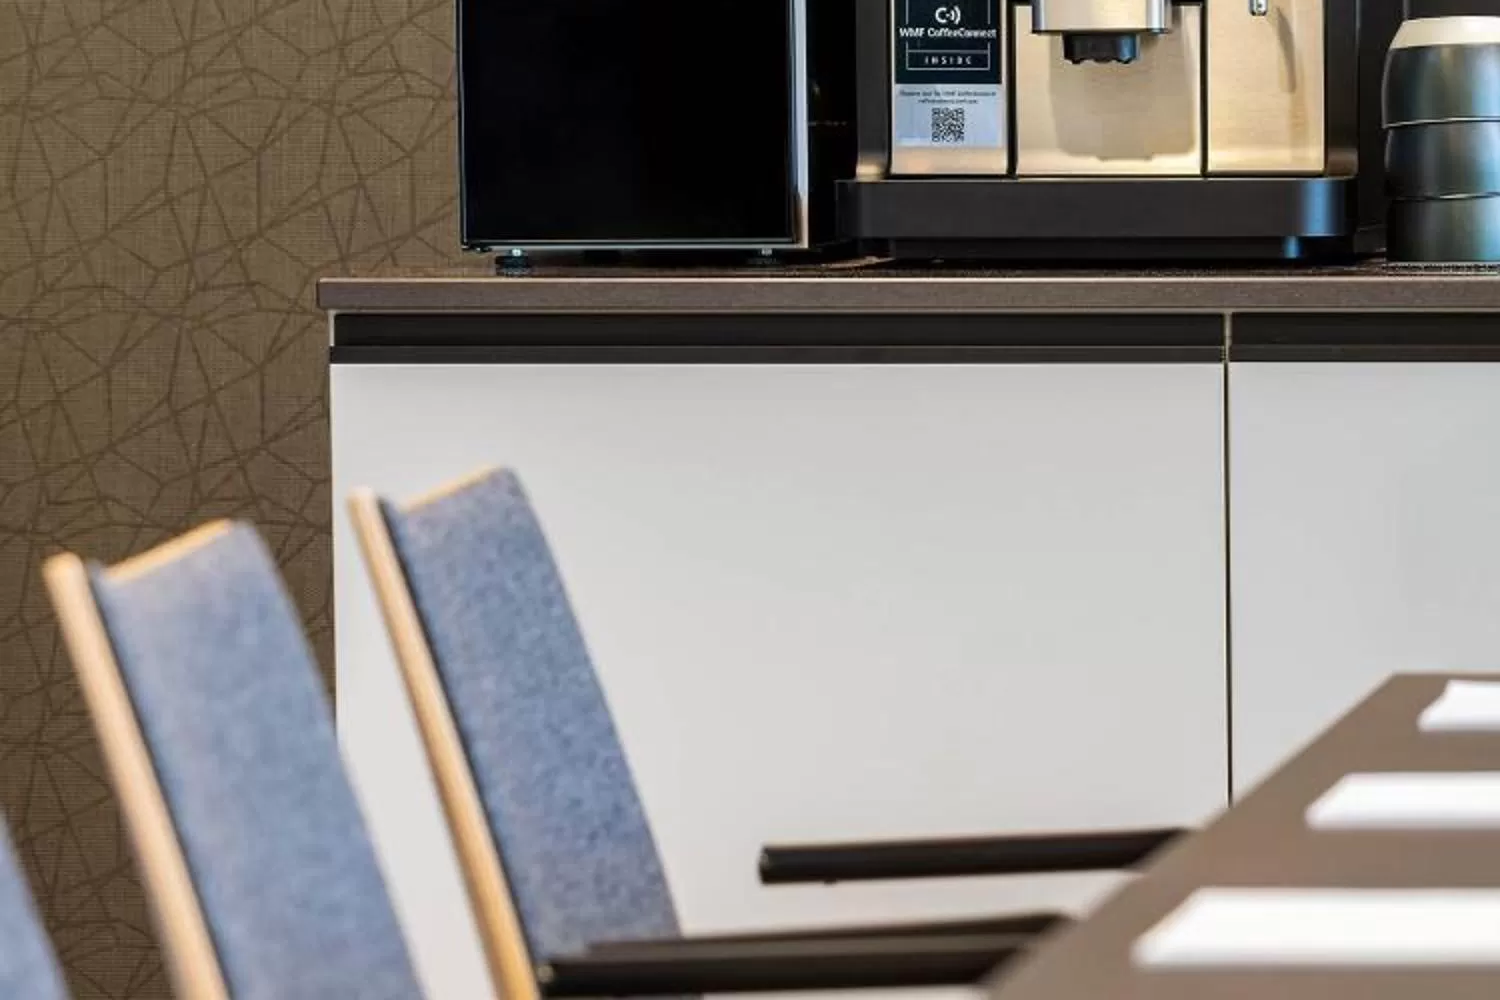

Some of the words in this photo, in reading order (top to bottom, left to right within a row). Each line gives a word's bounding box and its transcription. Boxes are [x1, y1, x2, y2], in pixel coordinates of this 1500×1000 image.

[899, 27, 925, 37] WMF
[927, 27, 997, 38] CoffeeConnect
[925, 56, 972, 65] INSIDE
